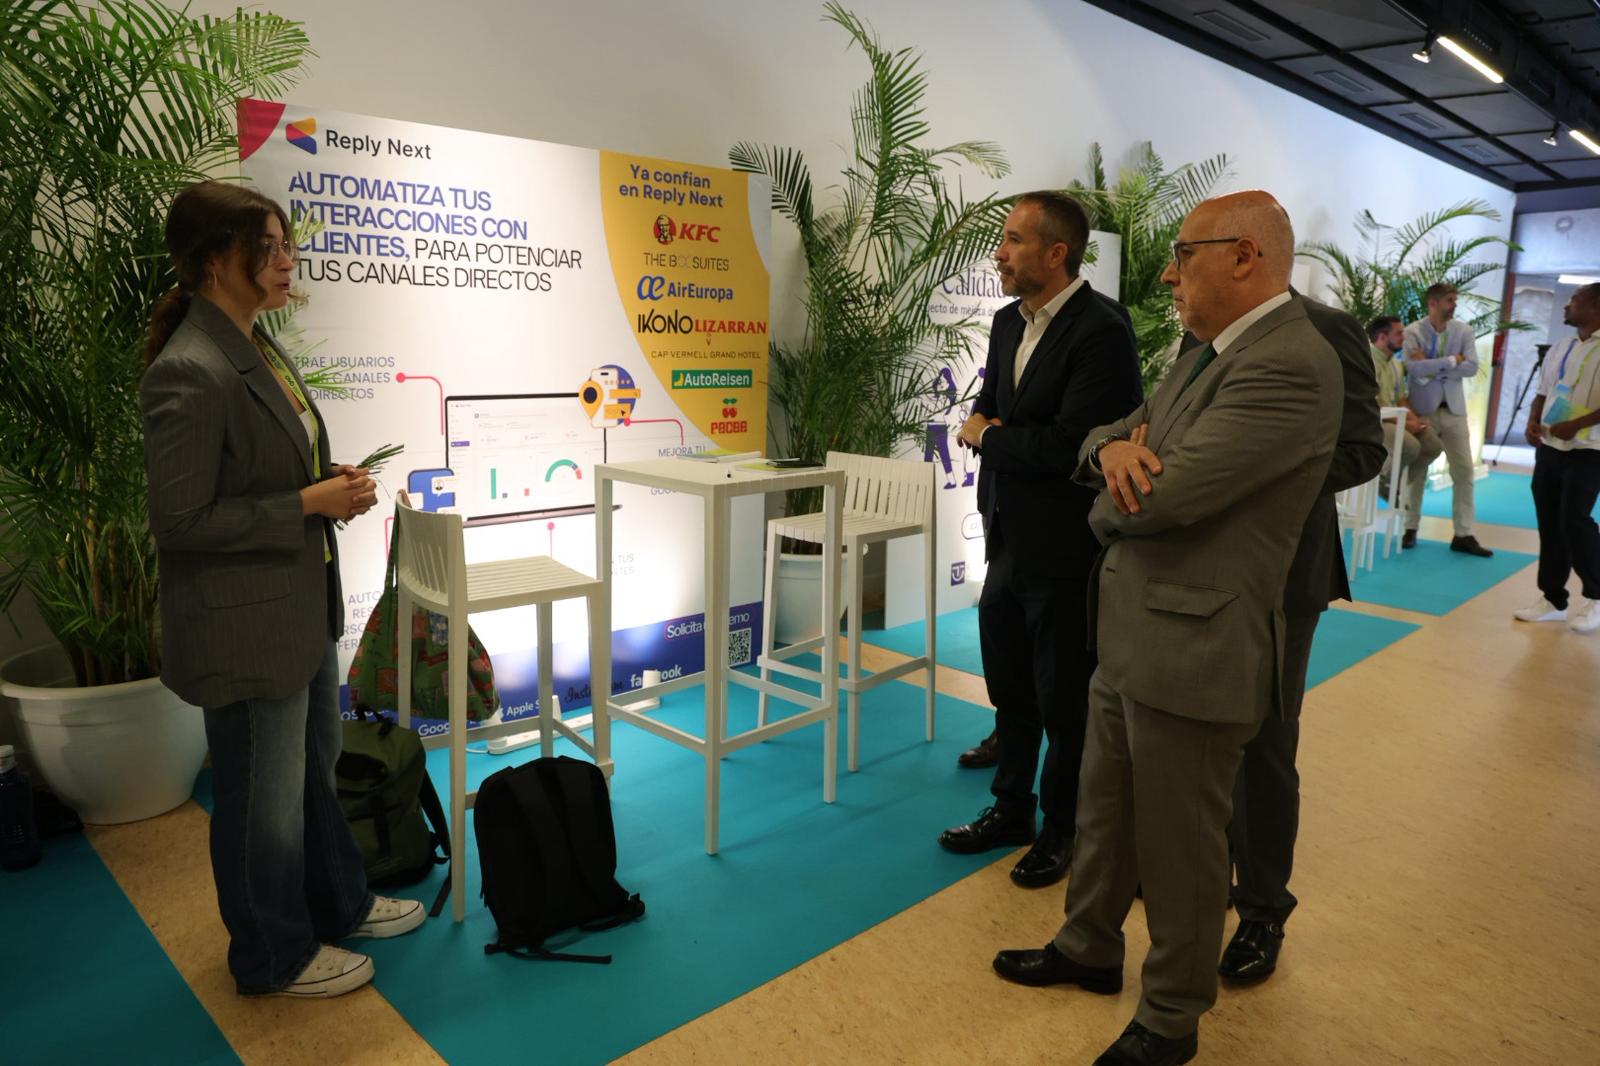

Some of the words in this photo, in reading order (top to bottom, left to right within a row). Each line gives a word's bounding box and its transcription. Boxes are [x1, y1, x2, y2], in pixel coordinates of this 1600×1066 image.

[325, 129, 382, 157] Reply
[387, 138, 432, 160] Next
[630, 163, 650, 181] Ya
[288, 171, 445, 207] AUTOMATIZA
[448, 187, 492, 212] TUS
[619, 183, 639, 198] en
[643, 184, 686, 207] Reply
[689, 190, 724, 208] Next
[289, 199, 477, 238] INTERACCIONES
[481, 216, 528, 241] CON
[678, 222, 721, 244] KFC
[414, 238, 471, 263] PARA
[475, 241, 582, 270] POTENCIAR
[643, 252, 667, 267] THE
[297, 257, 342, 282] TUS
[346, 260, 450, 289] CANALES
[454, 267, 552, 293] DIRECTOS
[667, 281, 733, 303] AirEuropa
[637, 308, 694, 334] IKONO
[694, 319, 767, 335] LIZARRAN
[330, 356, 395, 369] USUARIOS
[651, 350, 669, 359] CAP
[670, 350, 709, 360] VERMELL
[709, 351, 737, 360] GRAND
[737, 351, 761, 360] HOTEL
[333, 372, 391, 384] CANALES
[684, 373, 750, 386] AutoReisen
[658, 446, 694, 457] MEJORA
[666, 620, 703, 639] Solicita
[729, 612, 750, 626] emo
[506, 701, 534, 717] Apple
[417, 722, 450, 737] Goog
